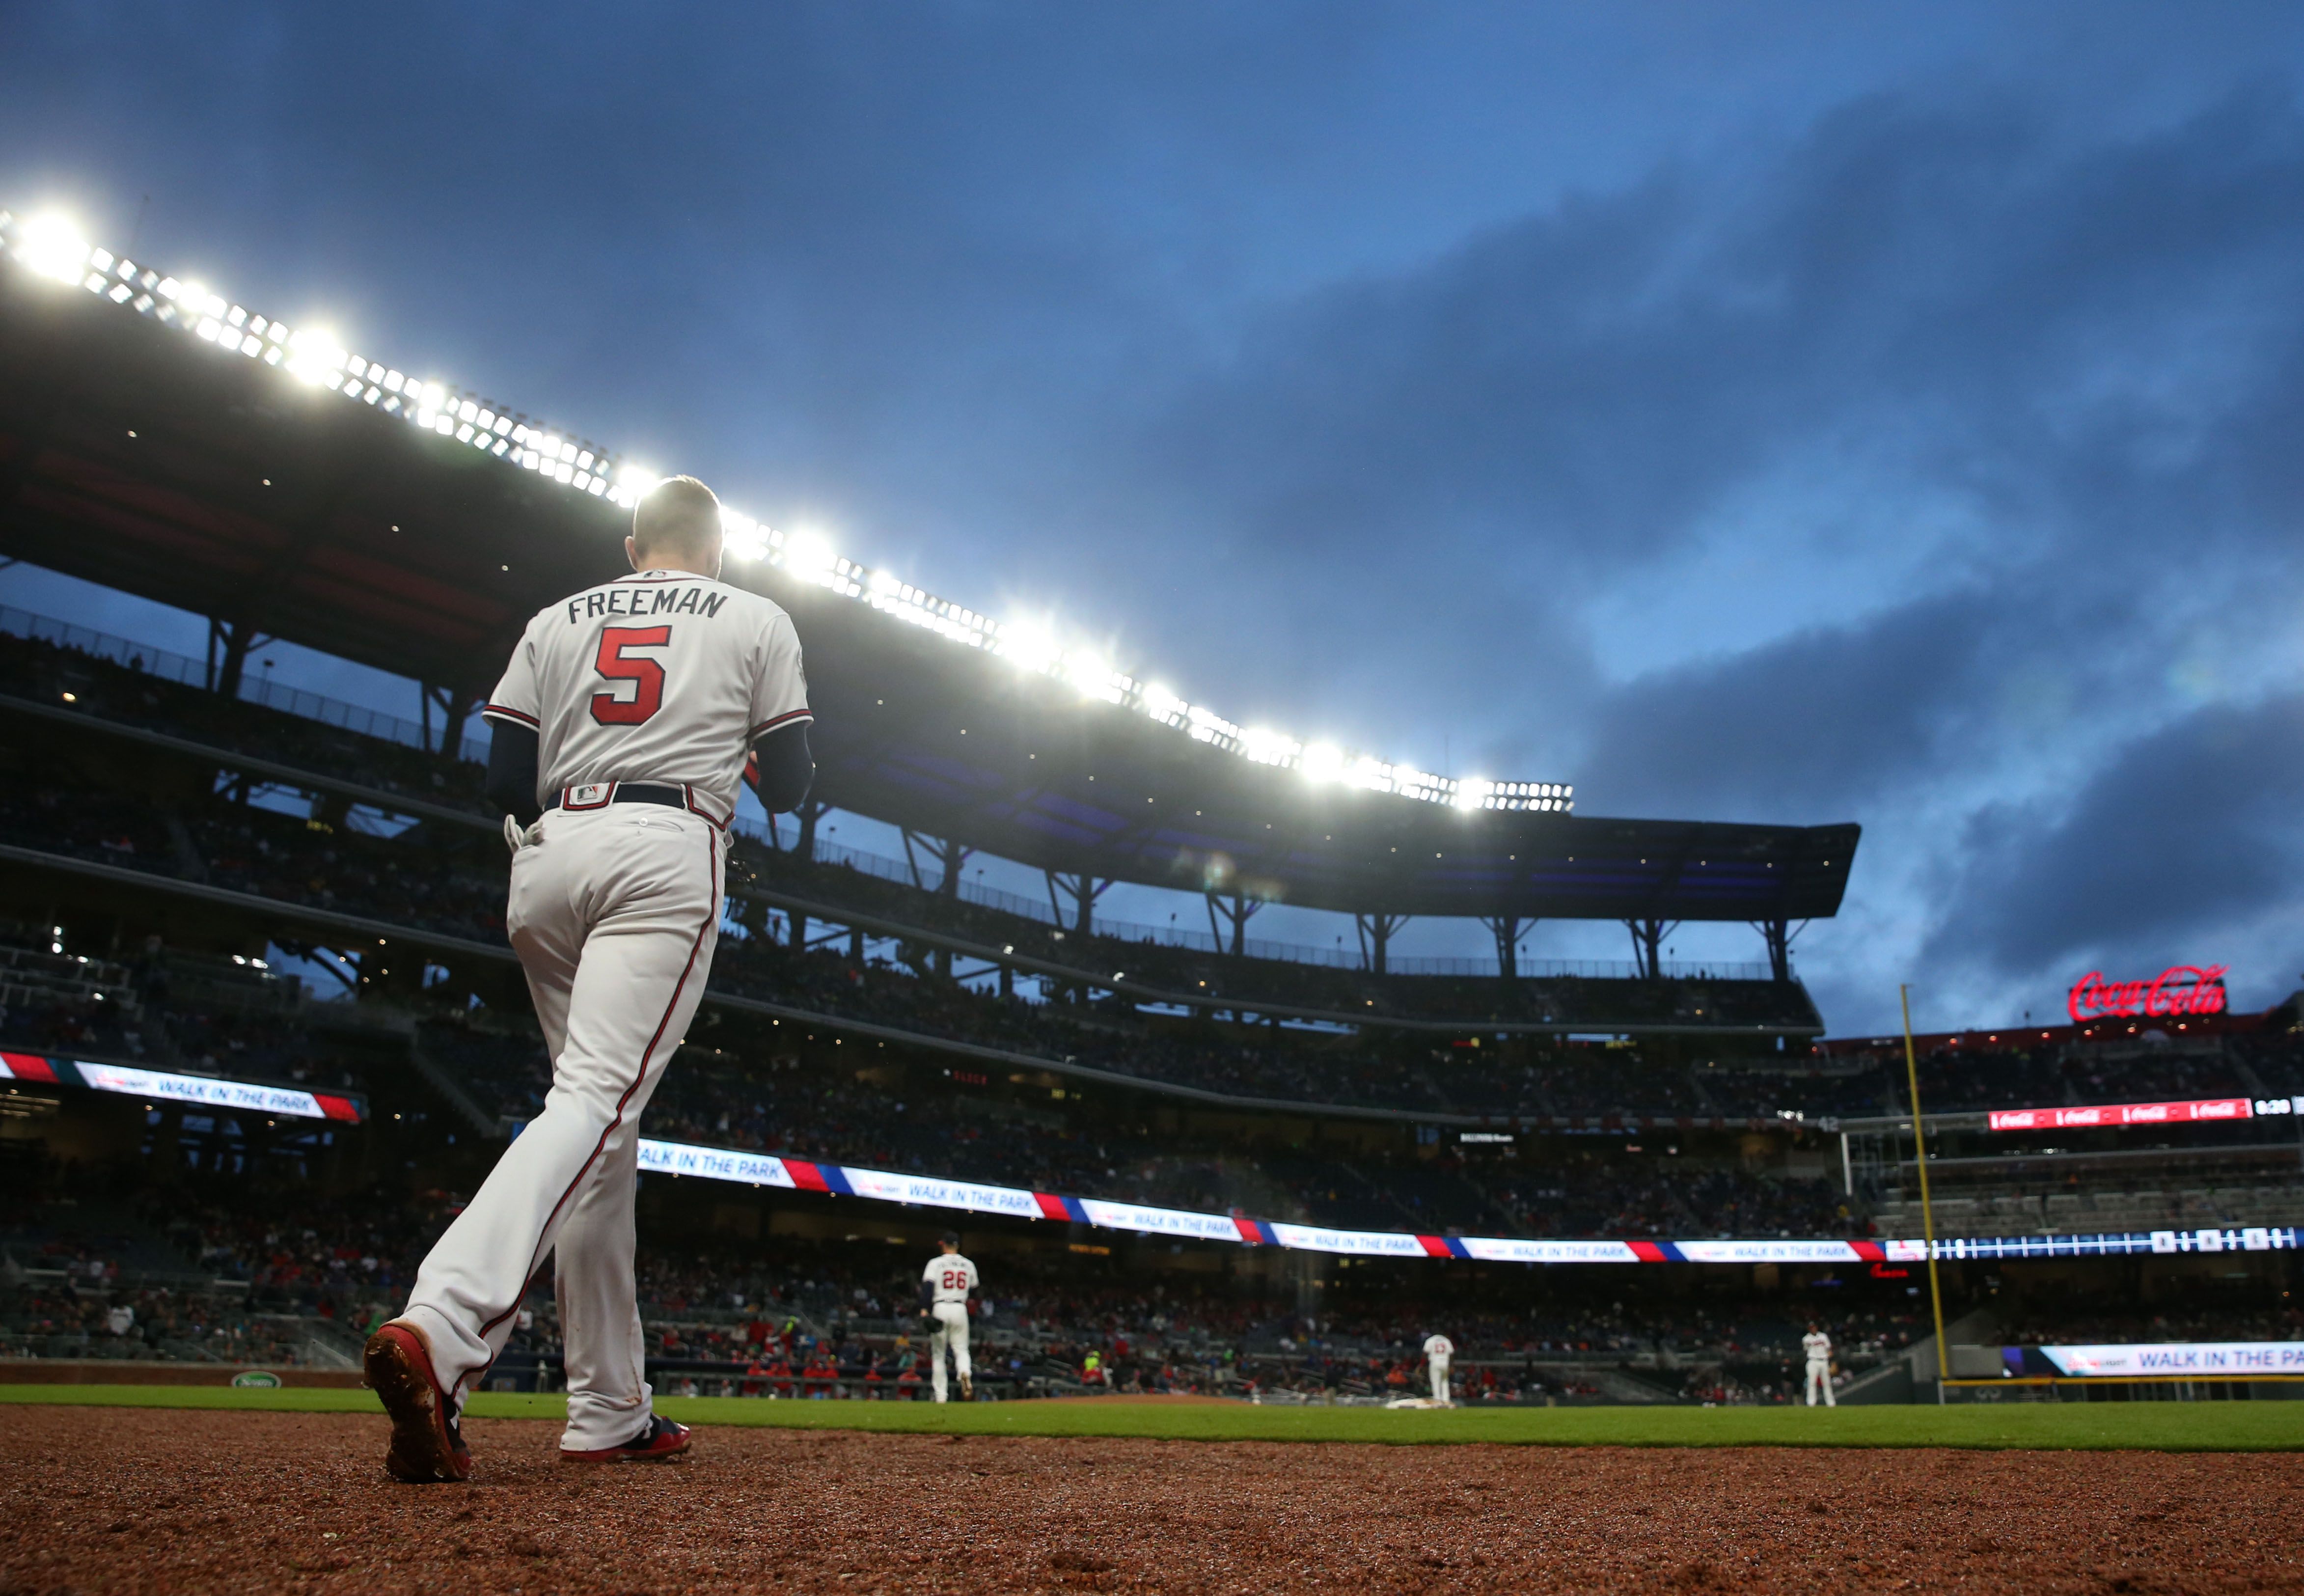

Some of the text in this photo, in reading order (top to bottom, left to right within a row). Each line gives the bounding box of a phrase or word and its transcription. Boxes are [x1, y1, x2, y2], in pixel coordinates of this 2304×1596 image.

[569, 588, 728, 624] FREEMAN
[590, 625, 672, 726] 5
[2068, 963, 2231, 1022] Coca-Cola
[159, 1079, 205, 1098] WALK
[212, 1087, 228, 1099] IN
[236, 1088, 264, 1104] THE
[269, 1093, 310, 1110] PARK
[638, 1147, 782, 1179] ALK IN THE PARK
[909, 1182, 948, 1198] WALK
[952, 1189, 964, 1202] IN
[970, 1190, 995, 1205] THE
[999, 1195, 1032, 1210] PARK
[1134, 1212, 1163, 1226] WALK
[1169, 1217, 1179, 1227] IN
[1184, 1217, 1202, 1231] THE
[1206, 1220, 1232, 1234] PARK
[1315, 1235, 1338, 1247] WALK
[1344, 1237, 1354, 1247] IN
[1360, 1237, 1379, 1248] THE
[1386, 1238, 1415, 1250] PARK
[1514, 1246, 1544, 1257] WALK
[1548, 1246, 1561, 1257] IN
[1566, 1246, 1589, 1257] THE
[1593, 1246, 1626, 1258] PARK
[1735, 1246, 1767, 1257] WALK
[1772, 1246, 1784, 1257] IN
[1791, 1245, 1812, 1257] THE
[1817, 1245, 1848, 1257] PARK
[943, 1269, 967, 1290] 26
[2139, 1351, 2198, 1367] WALK
[2205, 1351, 2226, 1366] IN
[2233, 1350, 2273, 1366] THE
